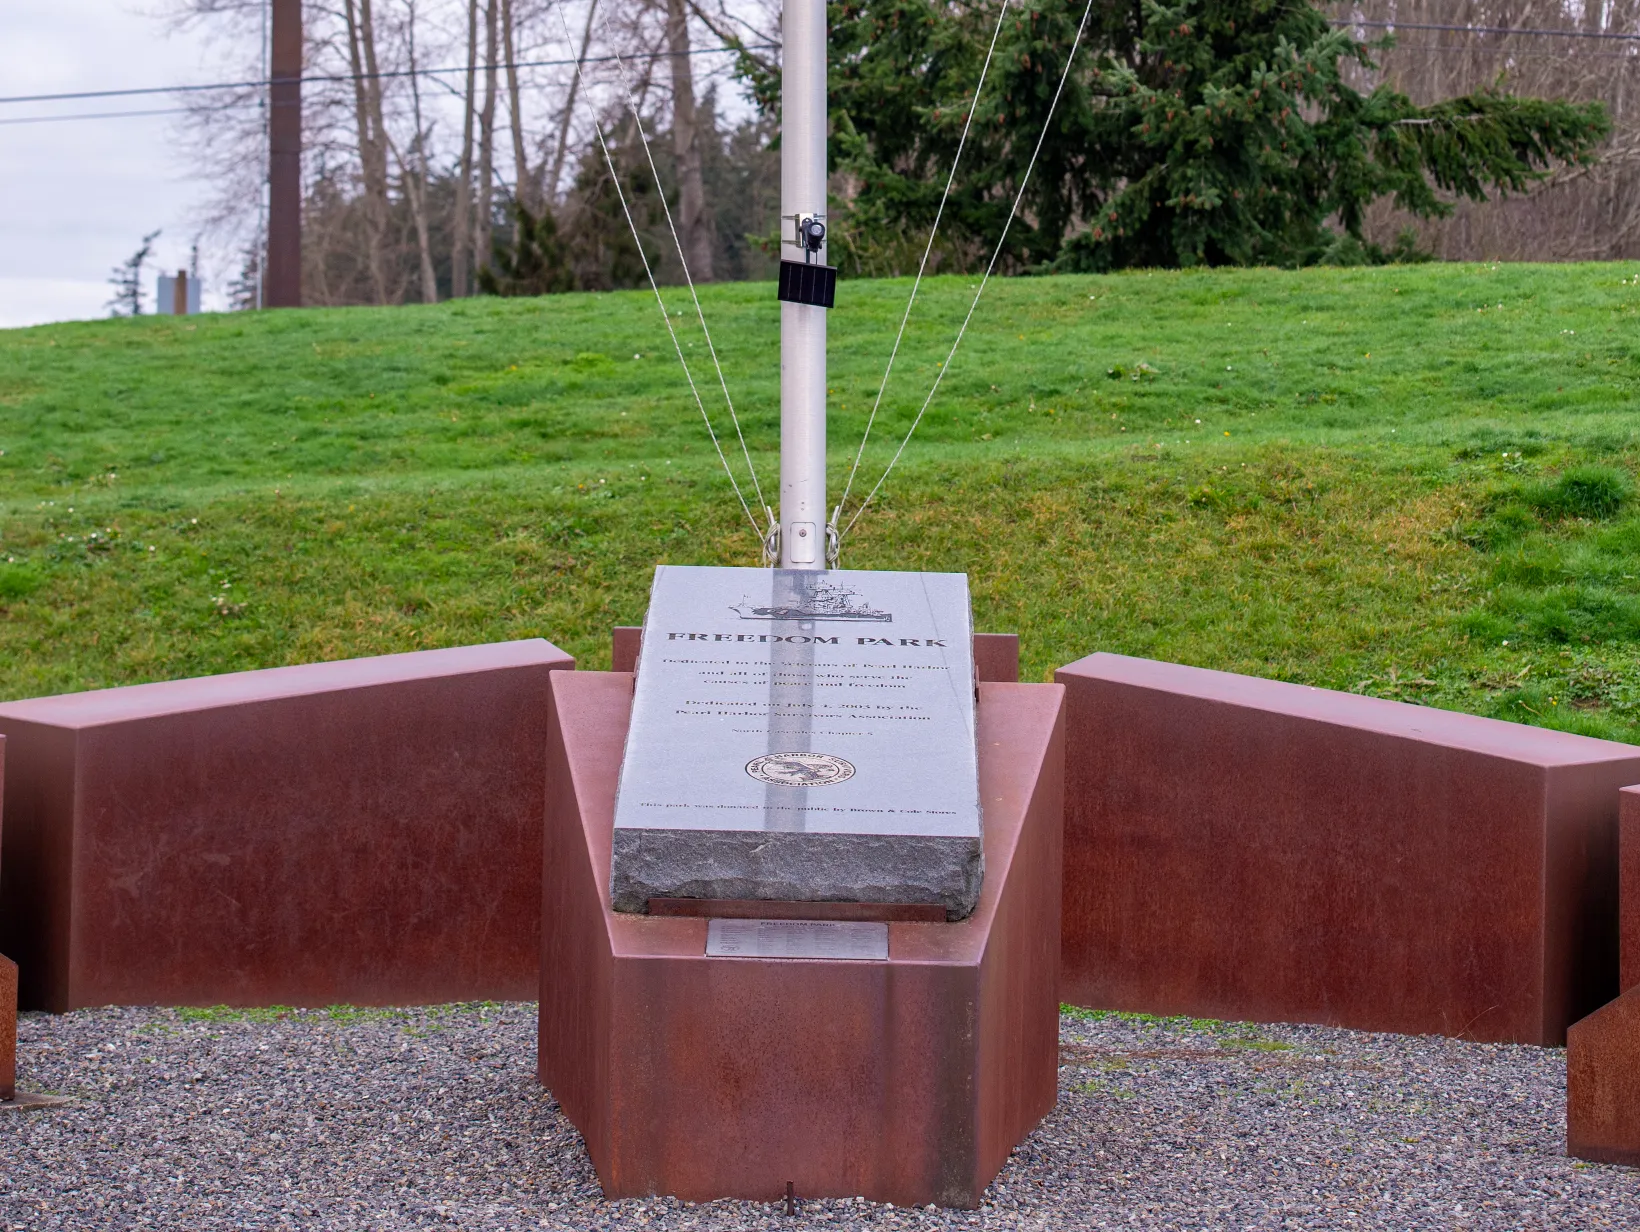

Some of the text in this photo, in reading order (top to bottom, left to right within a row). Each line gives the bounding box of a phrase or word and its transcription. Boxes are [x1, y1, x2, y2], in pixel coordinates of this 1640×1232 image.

[667, 631, 948, 648] FREEDOM PARK
[686, 699, 756, 707] Dedicated
